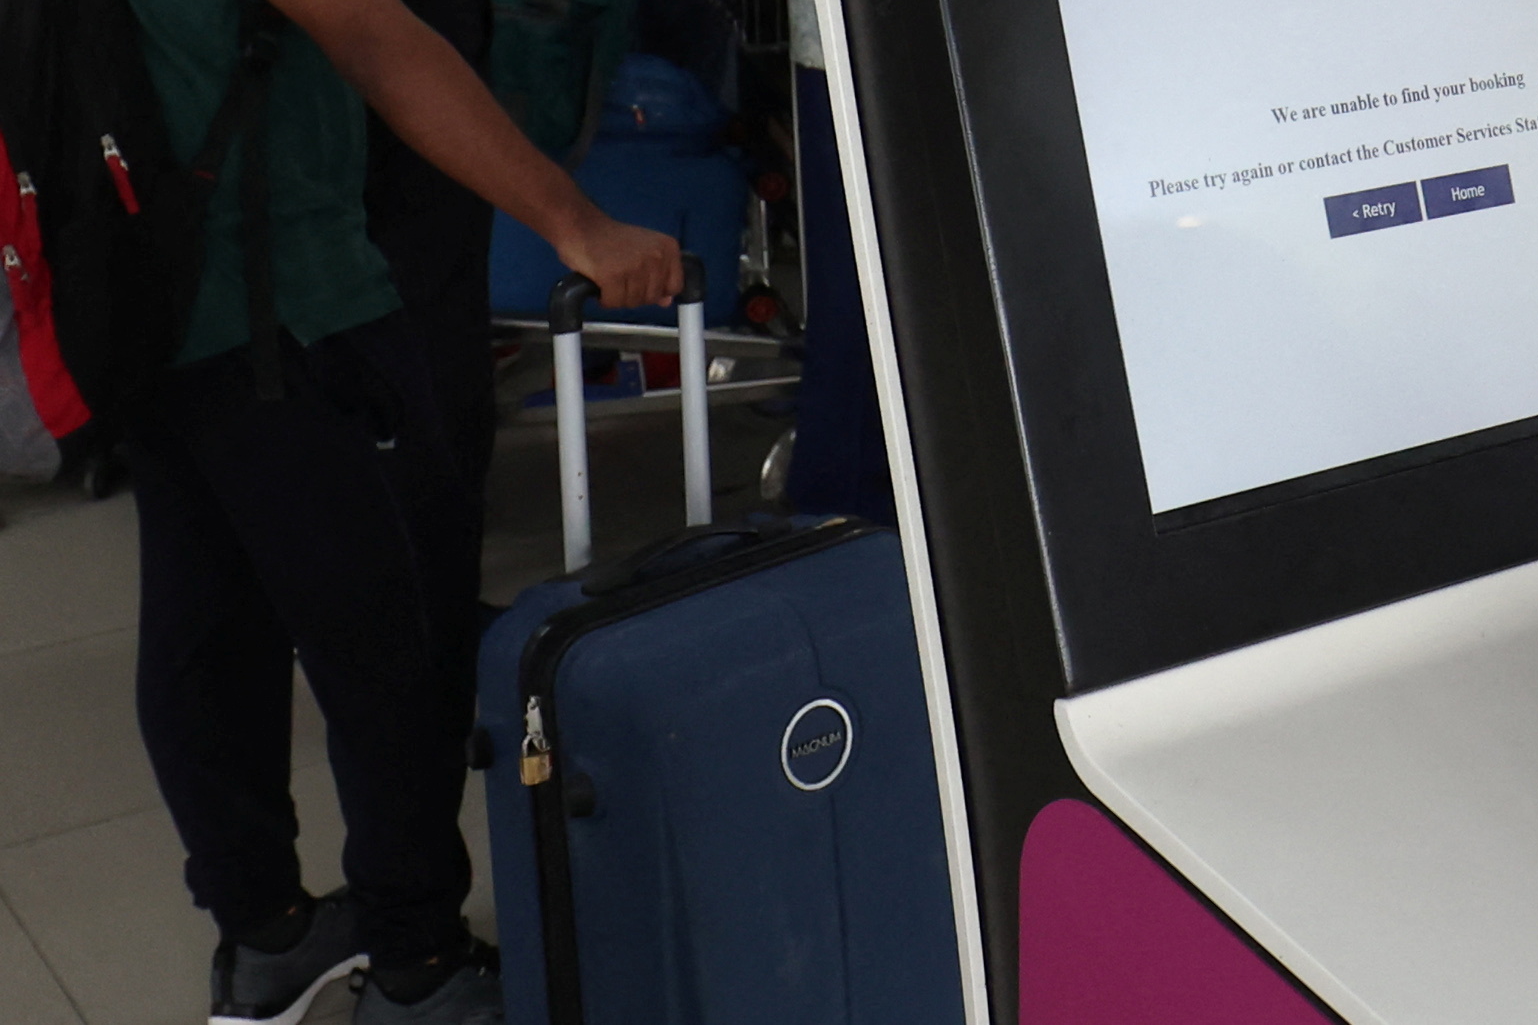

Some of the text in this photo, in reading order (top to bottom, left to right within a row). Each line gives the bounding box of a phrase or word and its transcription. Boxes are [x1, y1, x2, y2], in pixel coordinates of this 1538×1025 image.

[1270, 72, 1526, 124] We are unable to find your booking
[1148, 177, 1200, 198] Please
[1203, 173, 1227, 190] try
[1232, 163, 1274, 186] again
[1278, 160, 1295, 175] or
[1299, 147, 1353, 171] contact
[1356, 144, 1379, 161] the
[1383, 132, 1452, 157] Customer
[1456, 123, 1513, 144] Services
[1451, 185, 1485, 201] Home
[1362, 202, 1396, 219] Retry
